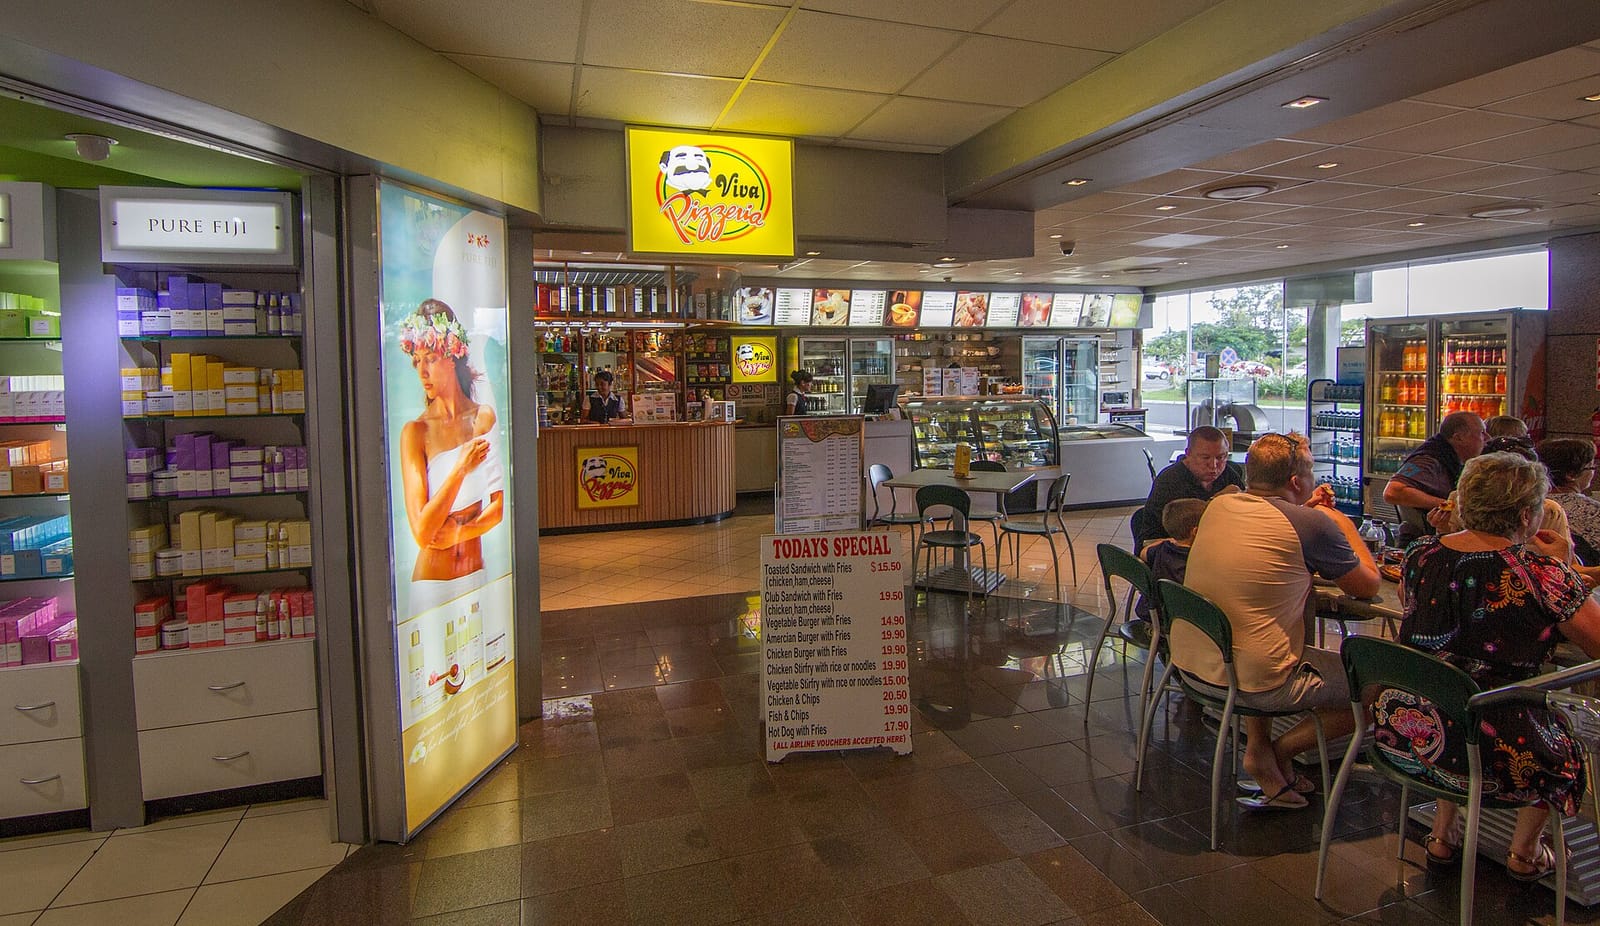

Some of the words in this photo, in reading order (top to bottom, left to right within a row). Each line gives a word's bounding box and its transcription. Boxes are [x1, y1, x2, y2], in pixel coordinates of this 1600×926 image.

[716, 173, 760, 198] Viva
[660, 193, 765, 244] Pizzeria
[148, 218, 203, 234] PURE
[212, 220, 247, 236] FIJI
[754, 352, 770, 360] Viva
[742, 384, 753, 392] NO
[608, 466, 631, 478] Viva
[584, 478, 632, 502] Pizzeria
[773, 538, 828, 559] TODAYS
[834, 535, 891, 557] SPECIAL
[765, 564, 789, 575] Toasted
[790, 563, 820, 574] Sandwich
[822, 563, 836, 573] with
[836, 562, 852, 572] Fries
[878, 562, 901, 572] 15.50
[765, 591, 780, 602] Club
[781, 590, 812, 601] Sandwich
[813, 590, 826, 600] with
[827, 590, 843, 600] Fries
[880, 592, 903, 600] 19.50
[766, 617, 798, 630] Vegetable
[799, 617, 820, 629] Burger
[821, 616, 834, 626] with
[835, 615, 851, 625] Fries
[881, 616, 904, 626] 14.90
[767, 633, 796, 644] Amercian
[798, 632, 819, 644] Burger
[821, 631, 834, 641] with
[836, 630, 851, 640] Fries
[882, 630, 905, 640] 19.90
[767, 648, 792, 659] Chicken
[794, 648, 816, 660] Burger
[817, 647, 830, 656] with
[831, 646, 847, 656] Fries
[882, 645, 906, 655] 19.90
[767, 664, 793, 675] Chicken
[794, 663, 814, 676] Stirfry
[815, 662, 829, 671] with
[830, 661, 842, 671] rice
[843, 662, 850, 671] or
[852, 660, 876, 671] noodles
[882, 660, 906, 670] 19.90
[768, 680, 799, 693] Vegetable
[800, 678, 820, 691] Stirfry
[821, 678, 835, 688] with
[850, 678, 857, 687] or
[858, 675, 882, 686] noodles
[882, 676, 906, 686] 15.00
[768, 695, 794, 706] Chicken
[796, 694, 800, 704] &
[802, 693, 821, 707] Chips
[883, 690, 907, 700] 20.50
[884, 704, 908, 714] 19.90
[768, 711, 783, 722] Fish
[784, 710, 789, 720] &
[790, 710, 809, 722] Chips
[768, 727, 780, 738] Hot
[782, 726, 794, 739] Dog
[796, 726, 810, 736] with
[811, 724, 828, 735] Fries
[884, 721, 909, 731] 17.90
[773, 742, 788, 750] (ALL
[790, 740, 815, 748] AIRLINE
[817, 738, 850, 747] VOUCHERS
[853, 736, 885, 745] ACCEPTED
[886, 734, 906, 744] HERE)
